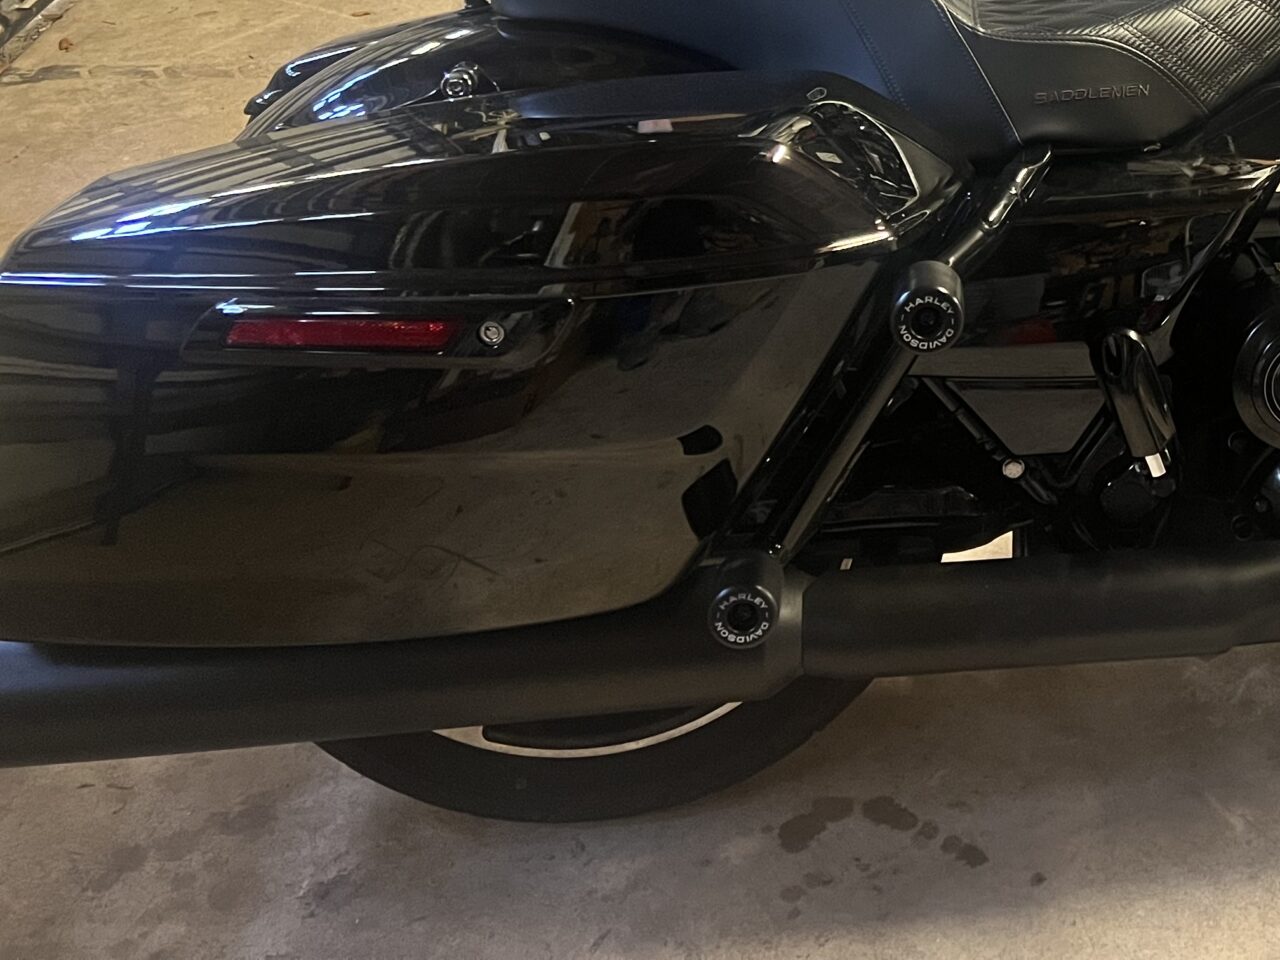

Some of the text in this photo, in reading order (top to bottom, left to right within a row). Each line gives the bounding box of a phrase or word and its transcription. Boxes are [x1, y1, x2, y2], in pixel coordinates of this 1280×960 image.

[1034, 84, 1150, 104] SADDLEMEN
[899, 296, 954, 349] HARLEY DAVIDSON
[714, 593, 769, 644] HARLEY DAVIDSON
